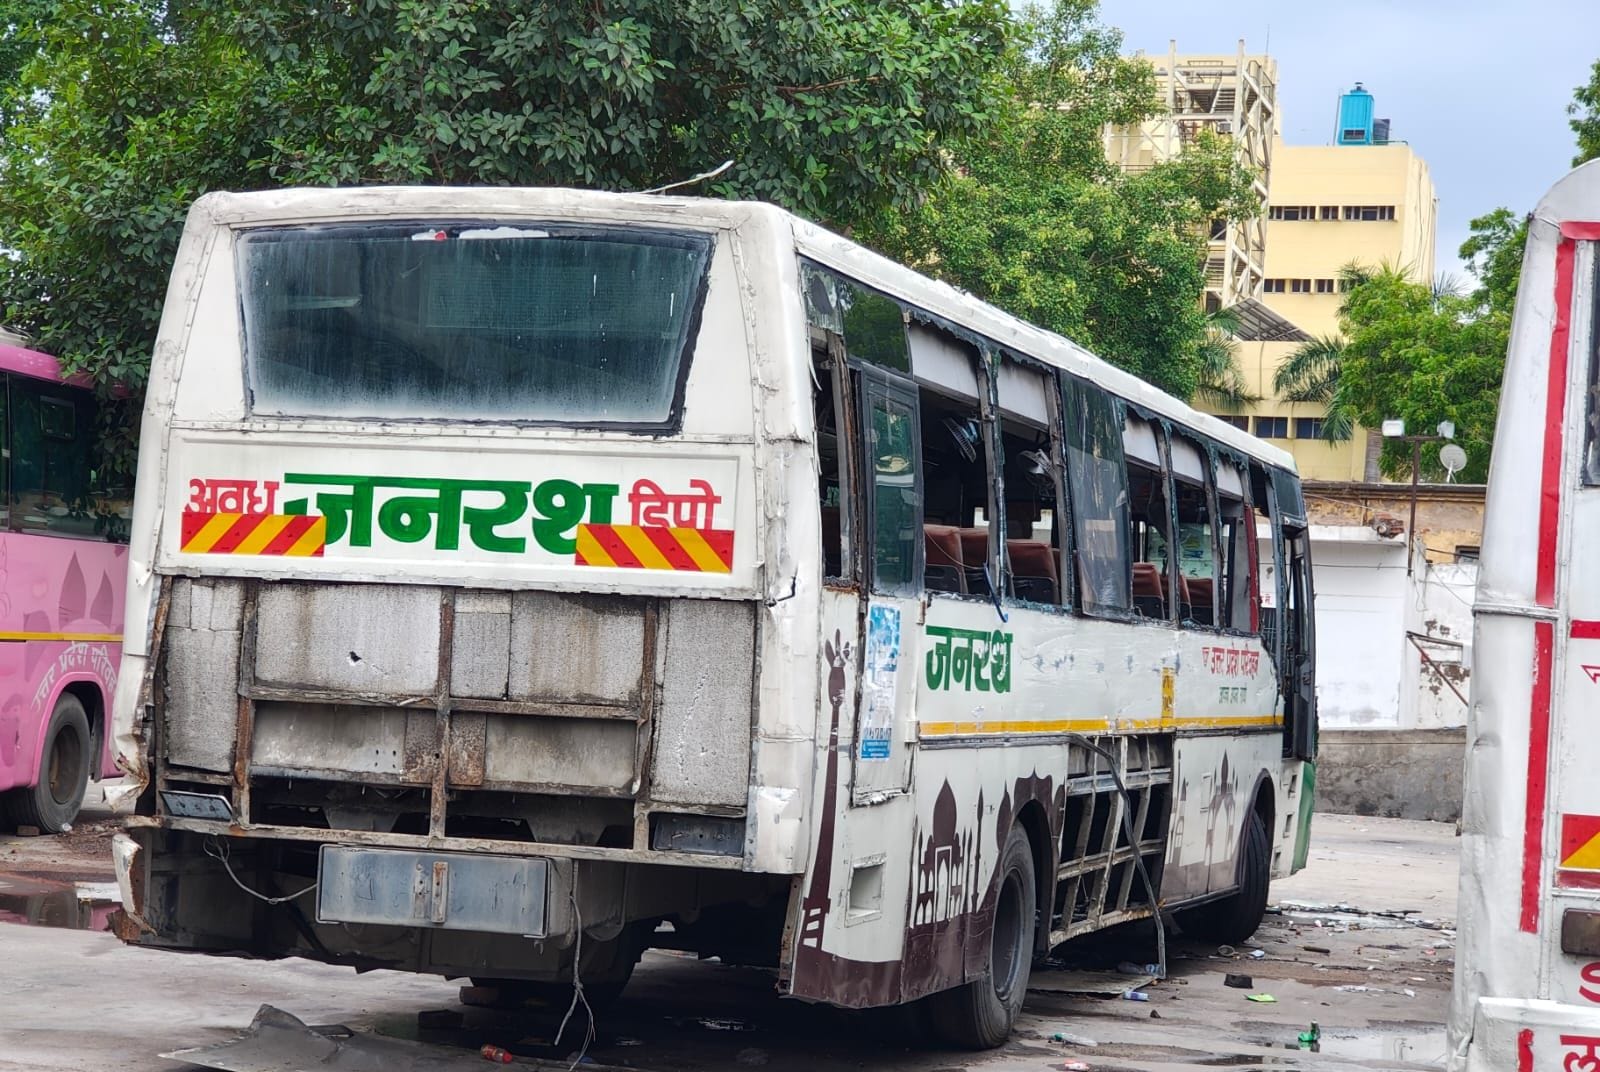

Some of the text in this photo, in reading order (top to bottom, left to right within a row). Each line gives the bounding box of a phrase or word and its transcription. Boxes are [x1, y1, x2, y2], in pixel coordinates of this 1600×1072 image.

[184, 472, 722, 555] अवध जनरथ डिपो
[925, 624, 1014, 694] जनरथ
